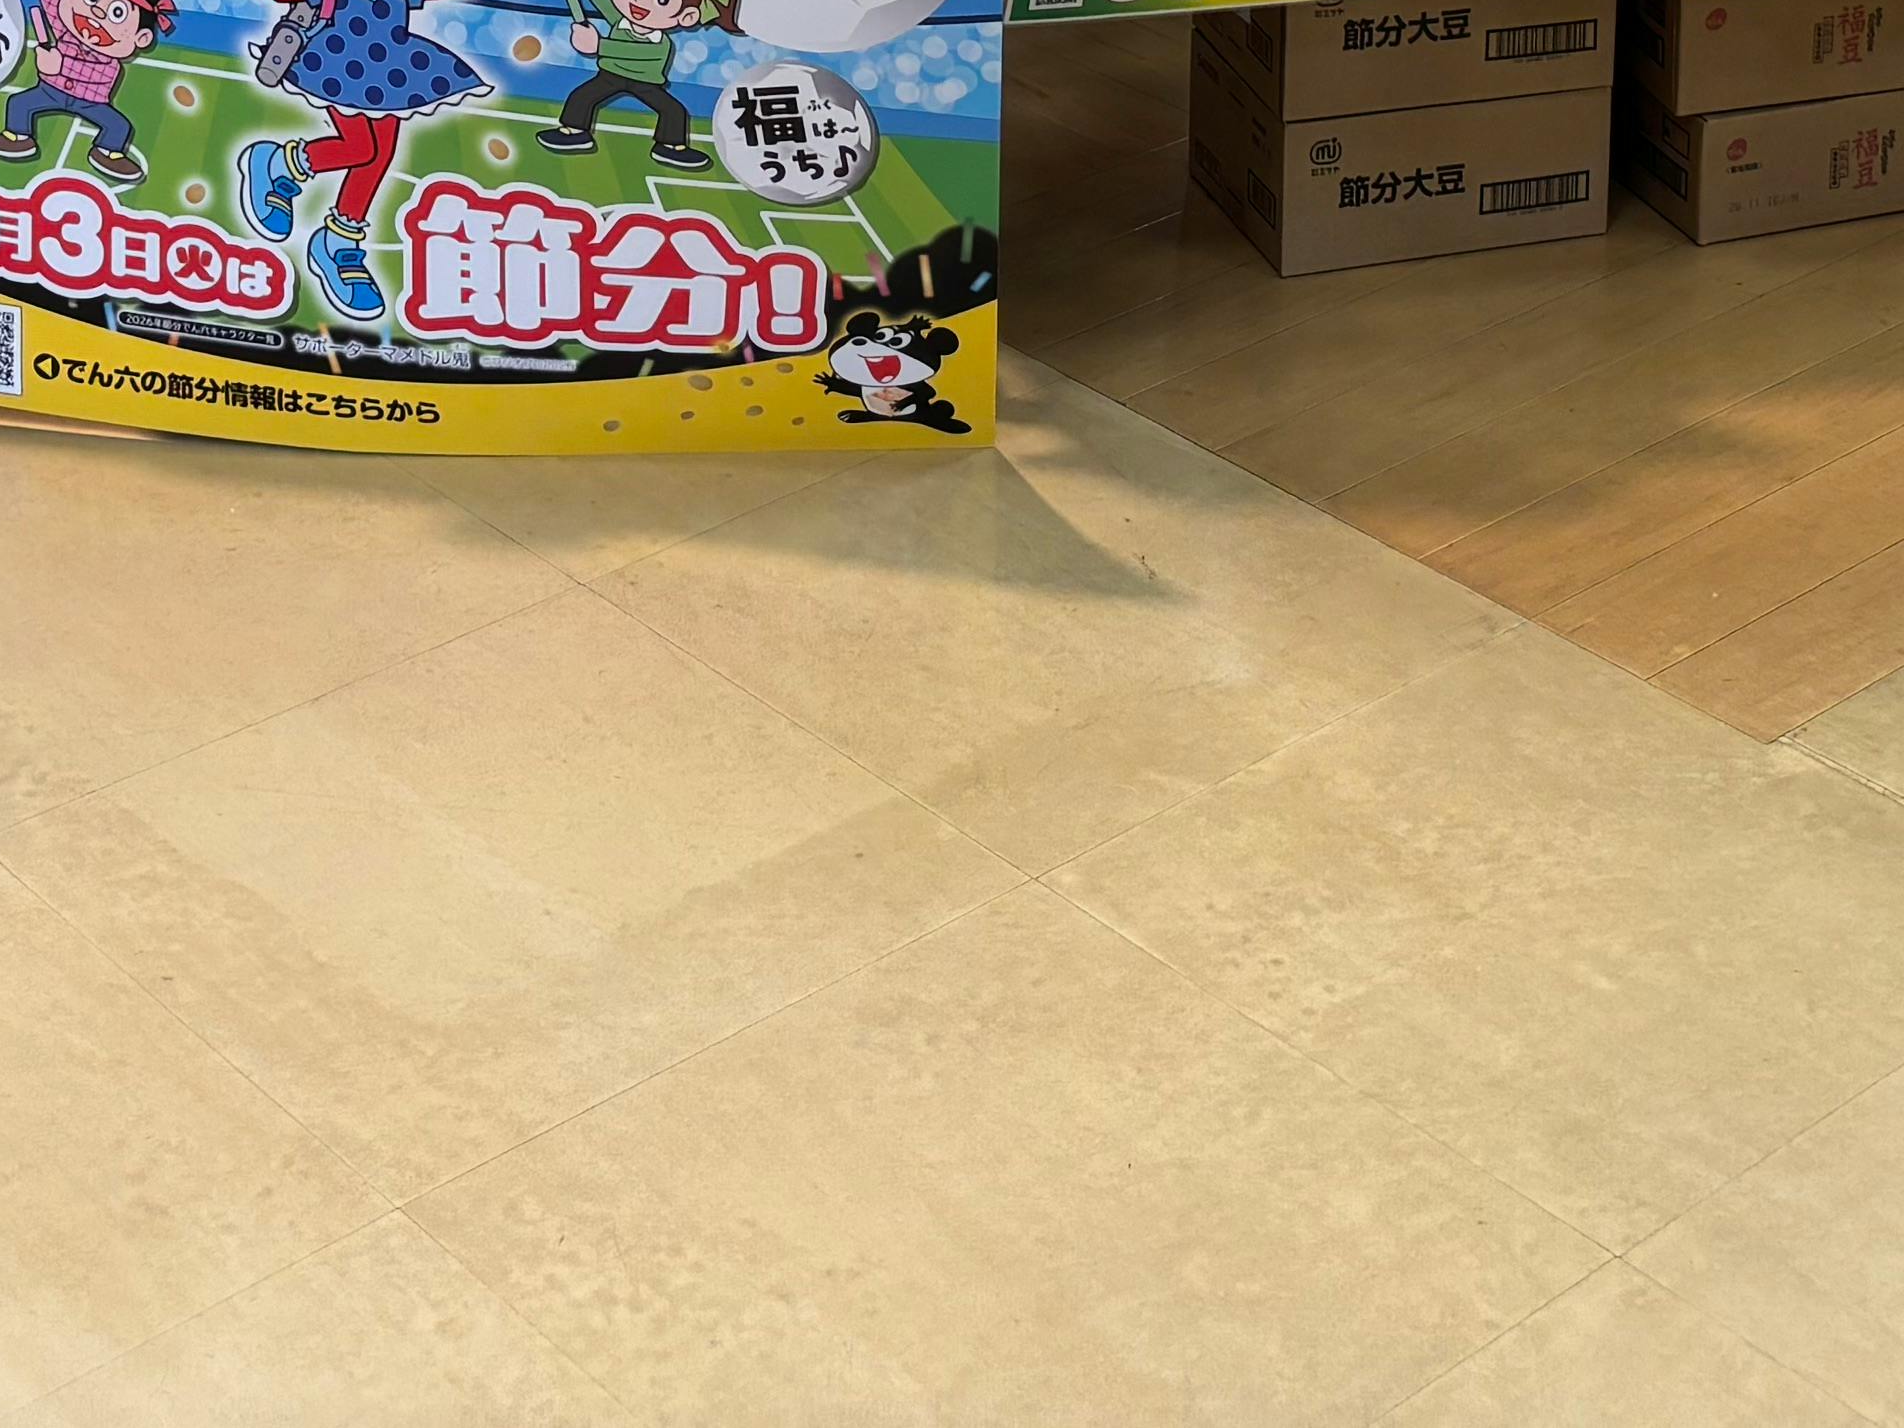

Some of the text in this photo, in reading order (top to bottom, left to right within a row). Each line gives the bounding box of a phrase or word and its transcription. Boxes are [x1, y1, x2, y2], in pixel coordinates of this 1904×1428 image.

[1342, 8, 1472, 51] 節分大豆
[1338, 163, 1467, 208] 節分大豆
[410, 180, 824, 346] 節分!
[60, 355, 442, 429] でん六の節分情報はこちらから
